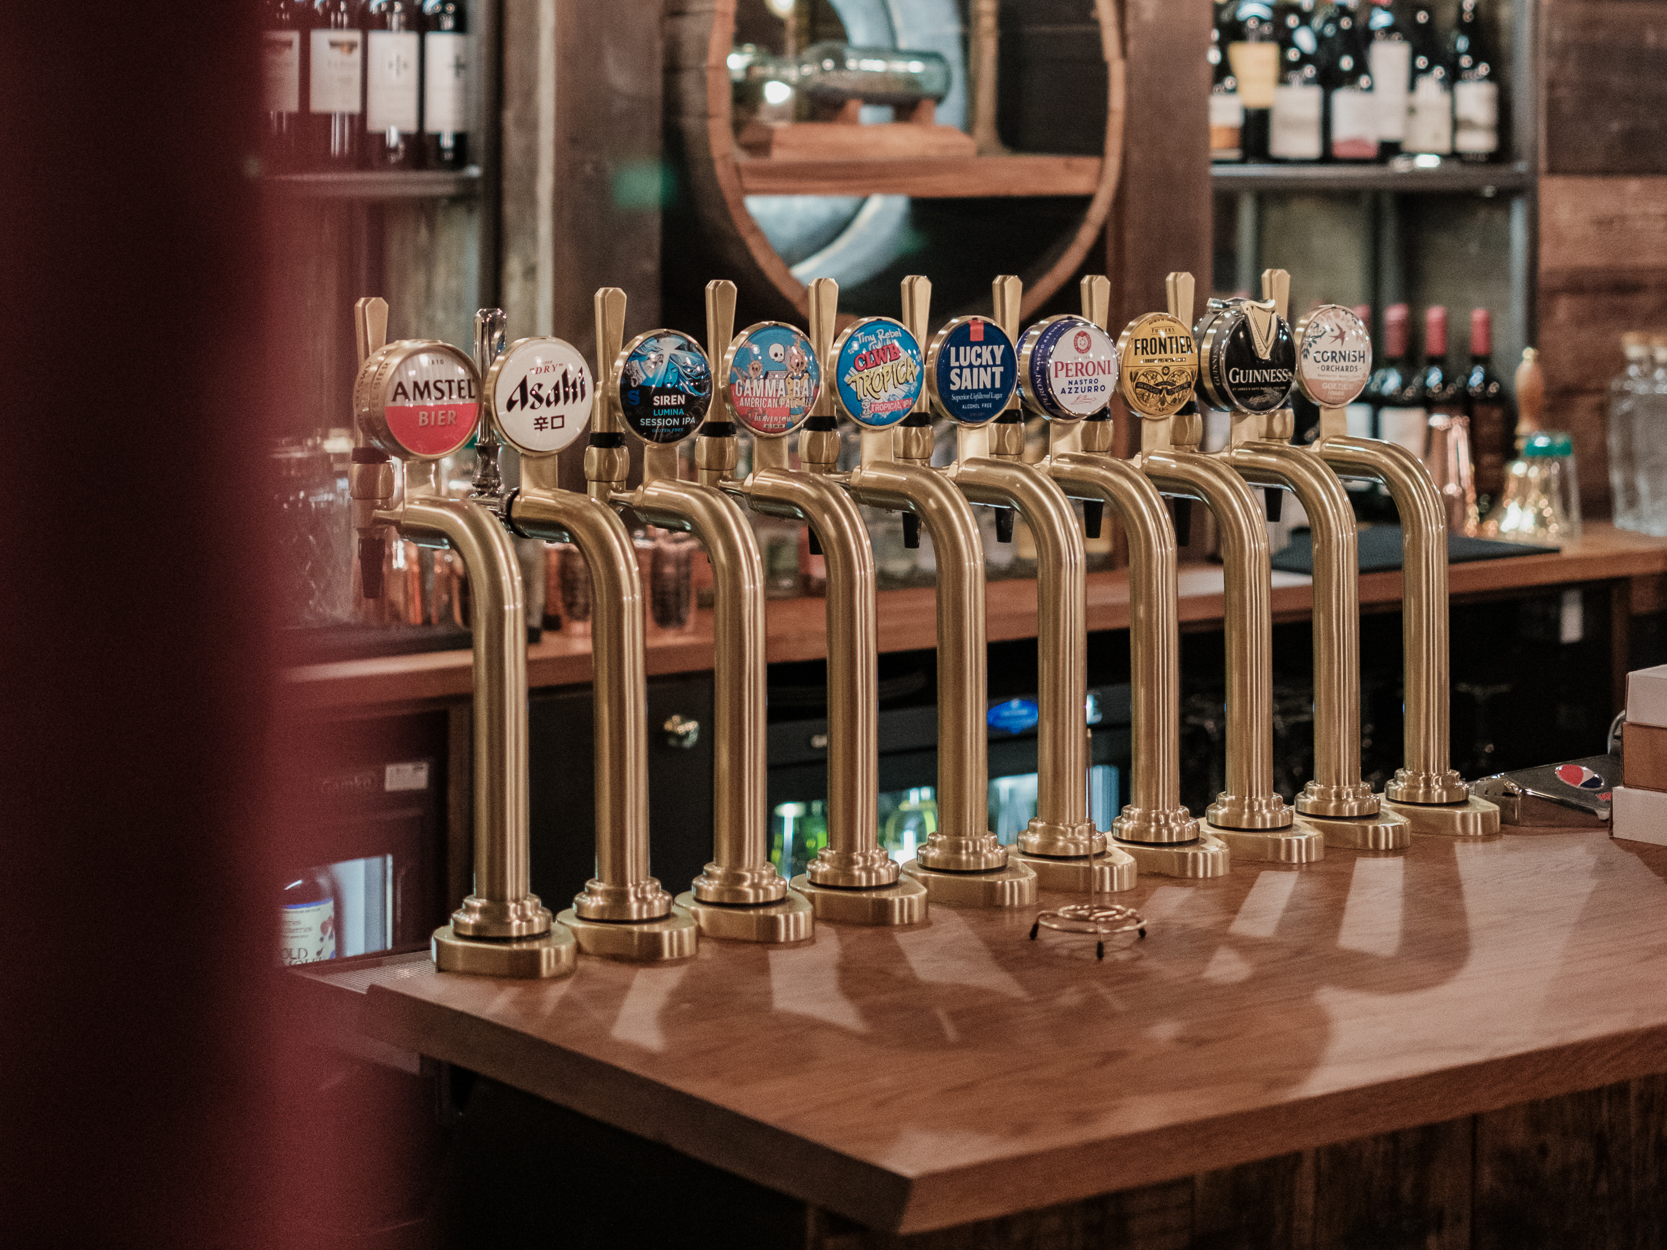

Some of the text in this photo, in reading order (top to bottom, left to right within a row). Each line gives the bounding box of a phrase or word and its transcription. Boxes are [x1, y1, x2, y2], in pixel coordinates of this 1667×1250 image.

[854, 328, 902, 344] Tiny Rebel
[1134, 336, 1194, 356] FRONTIER
[854, 342, 902, 372] CLWB
[950, 345, 1005, 367] LUCKY
[1313, 350, 1366, 364] CORNISH
[1054, 360, 1112, 378] PERONI
[1229, 367, 1289, 383] GUINNESS
[846, 356, 917, 401] TROPICA
[949, 366, 1004, 391] SAINT
[1068, 378, 1099, 386] NASTRO
[391, 378, 476, 402] AMSTEL
[506, 366, 586, 413] Asahi
[735, 378, 817, 398] GAMMA RAY
[1060, 385, 1106, 394] AZZURRO
[652, 394, 686, 406] SIREN
[739, 397, 778, 409] AMERICAN
[780, 398, 799, 408] PALE
[951, 392, 970, 402] Superior
[653, 408, 685, 416] LUMINA
[871, 401, 902, 413] TROPICAL
[418, 410, 457, 427] BIER
[533, 414, 565, 432] 辛口
[639, 416, 696, 426] SESSION IPA
